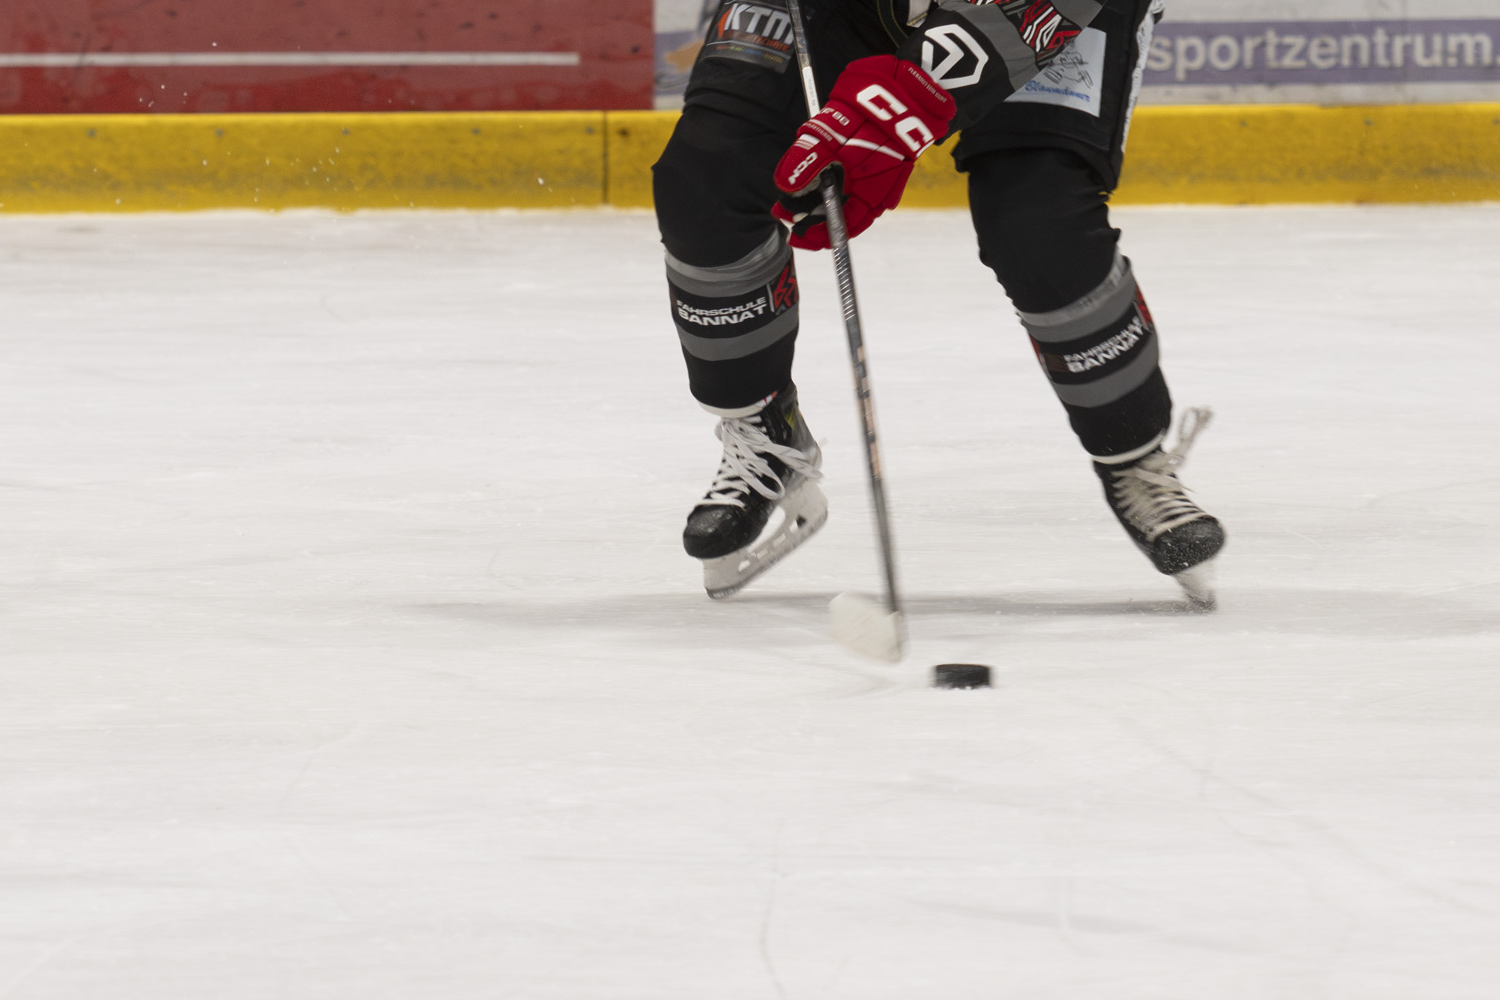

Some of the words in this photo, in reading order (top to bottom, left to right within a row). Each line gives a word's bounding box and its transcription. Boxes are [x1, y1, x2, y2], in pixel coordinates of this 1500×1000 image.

[724, 3, 794, 46] KTM
[857, 84, 935, 158] CC
[676, 296, 767, 316] FAHRSCHULE
[678, 303, 768, 326] BANNAT
